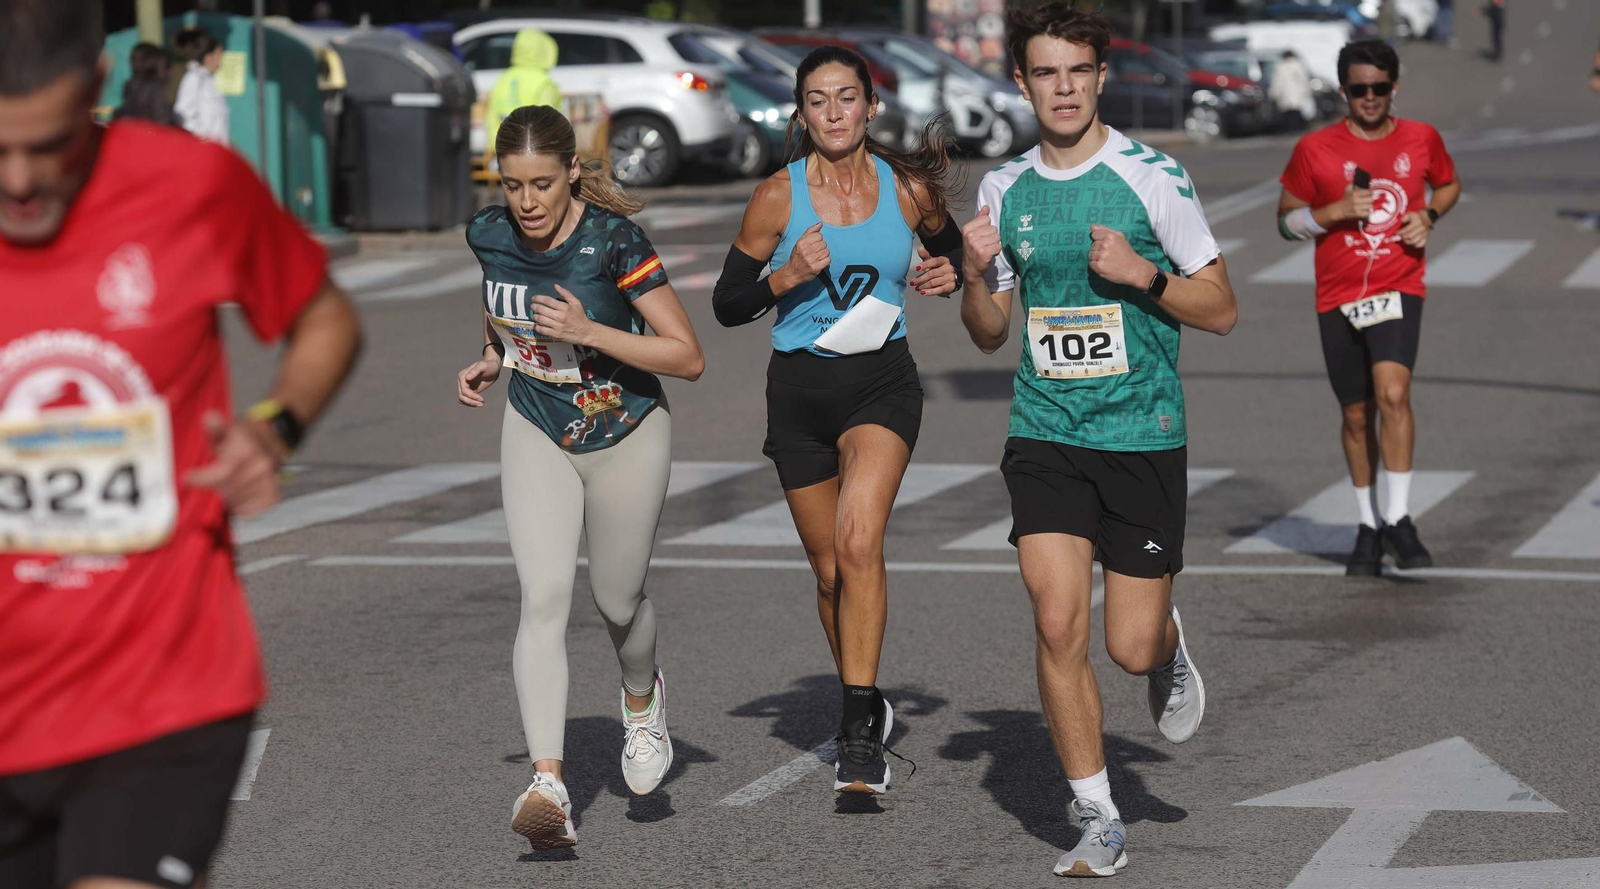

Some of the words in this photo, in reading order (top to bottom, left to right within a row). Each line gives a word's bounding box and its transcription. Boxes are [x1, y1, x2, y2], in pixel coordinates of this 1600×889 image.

[486, 280, 529, 320] VII
[811, 315, 840, 324] VANG
[512, 336, 552, 368] 55
[1038, 332, 1114, 361] 102
[0, 462, 140, 516] 324
